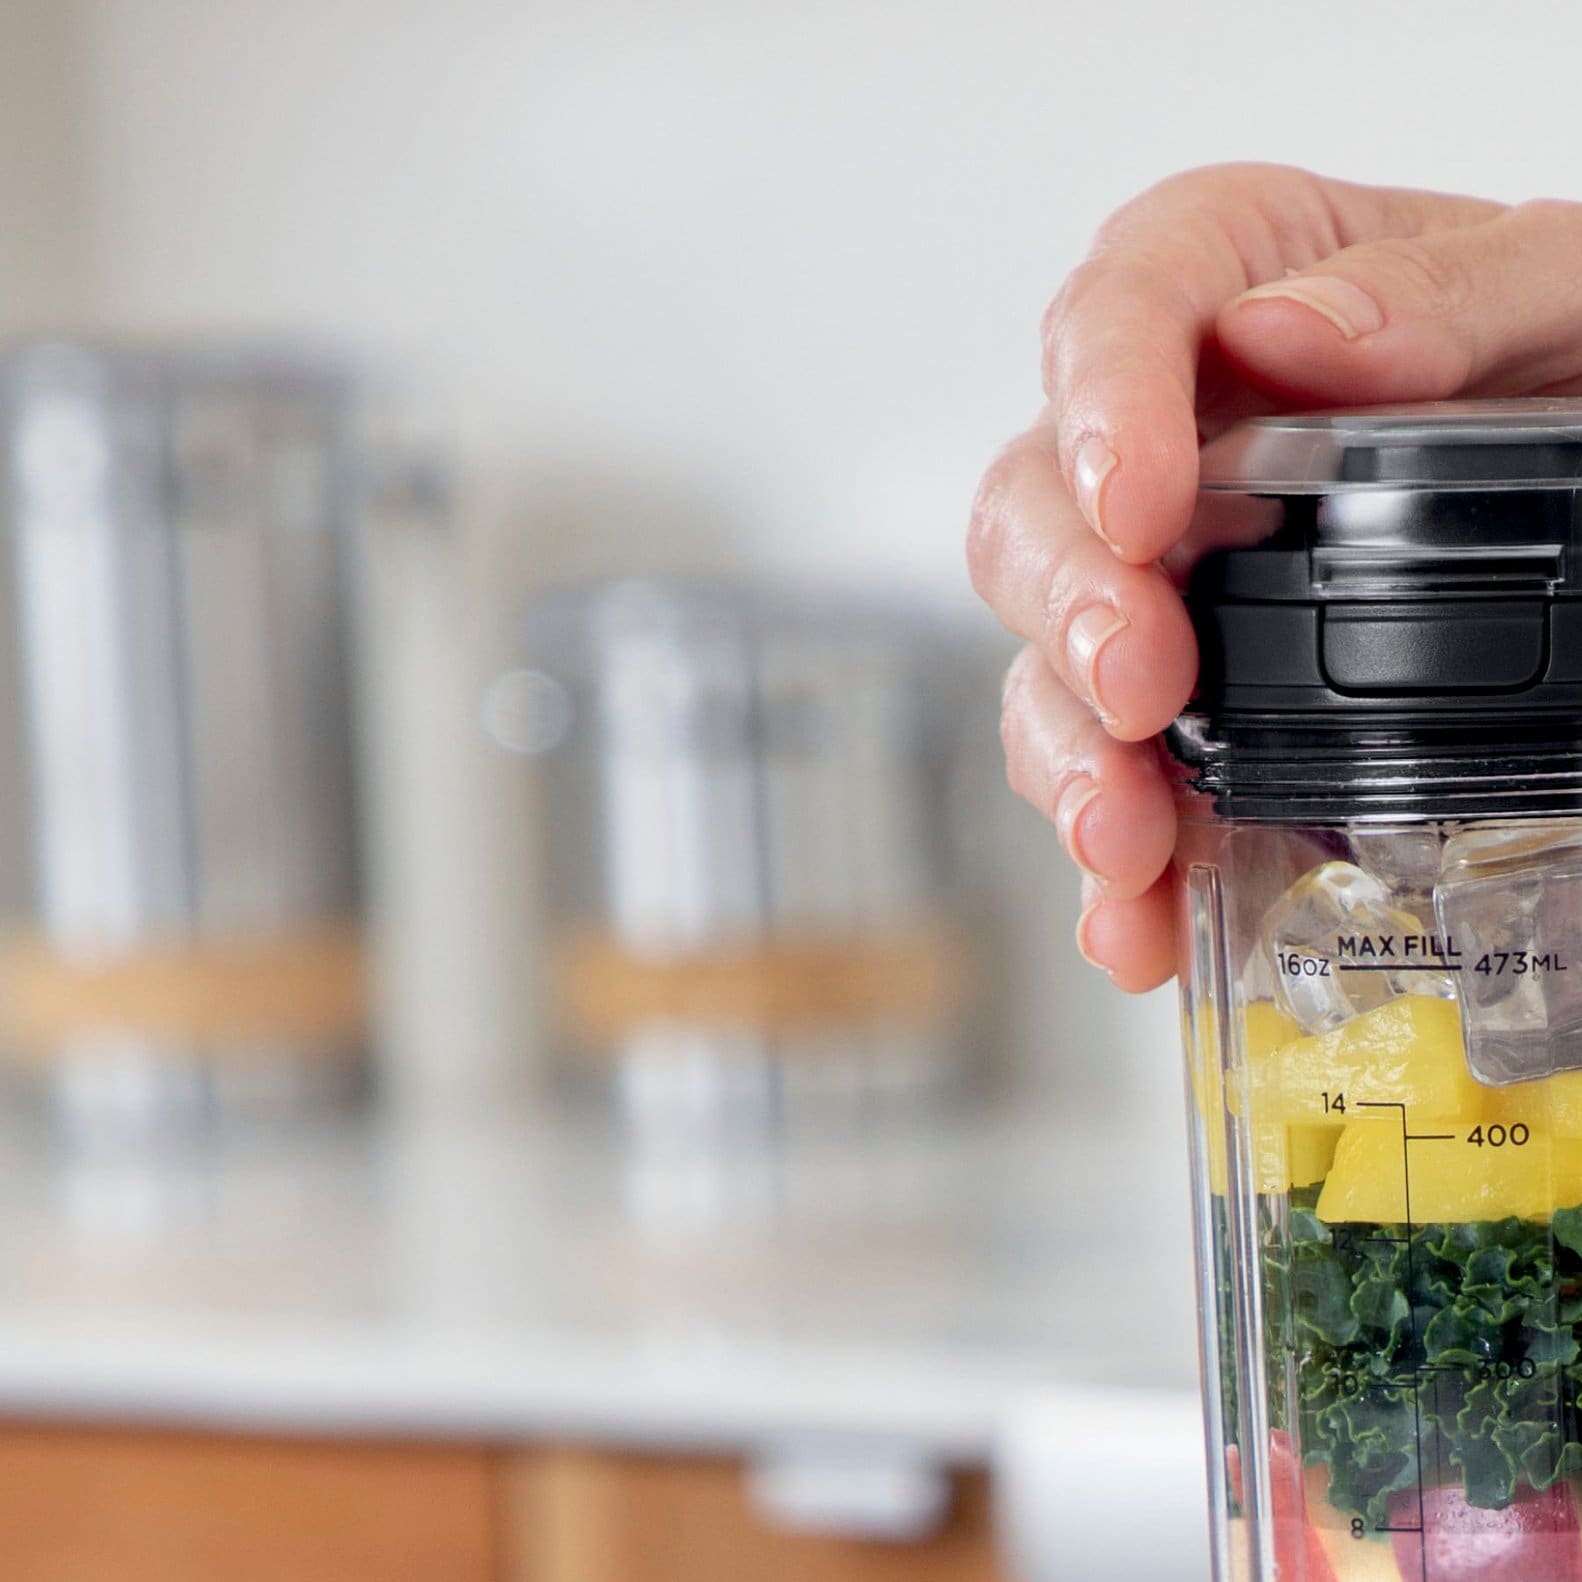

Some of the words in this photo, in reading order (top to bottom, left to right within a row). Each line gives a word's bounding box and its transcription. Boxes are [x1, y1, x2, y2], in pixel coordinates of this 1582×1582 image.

[1338, 936, 1395, 957] MAX
[1405, 935, 1462, 957] FILL
[1321, 1092, 1346, 1115] 14
[1467, 1123, 1530, 1147] 400
[1350, 1517, 1365, 1540] 8
